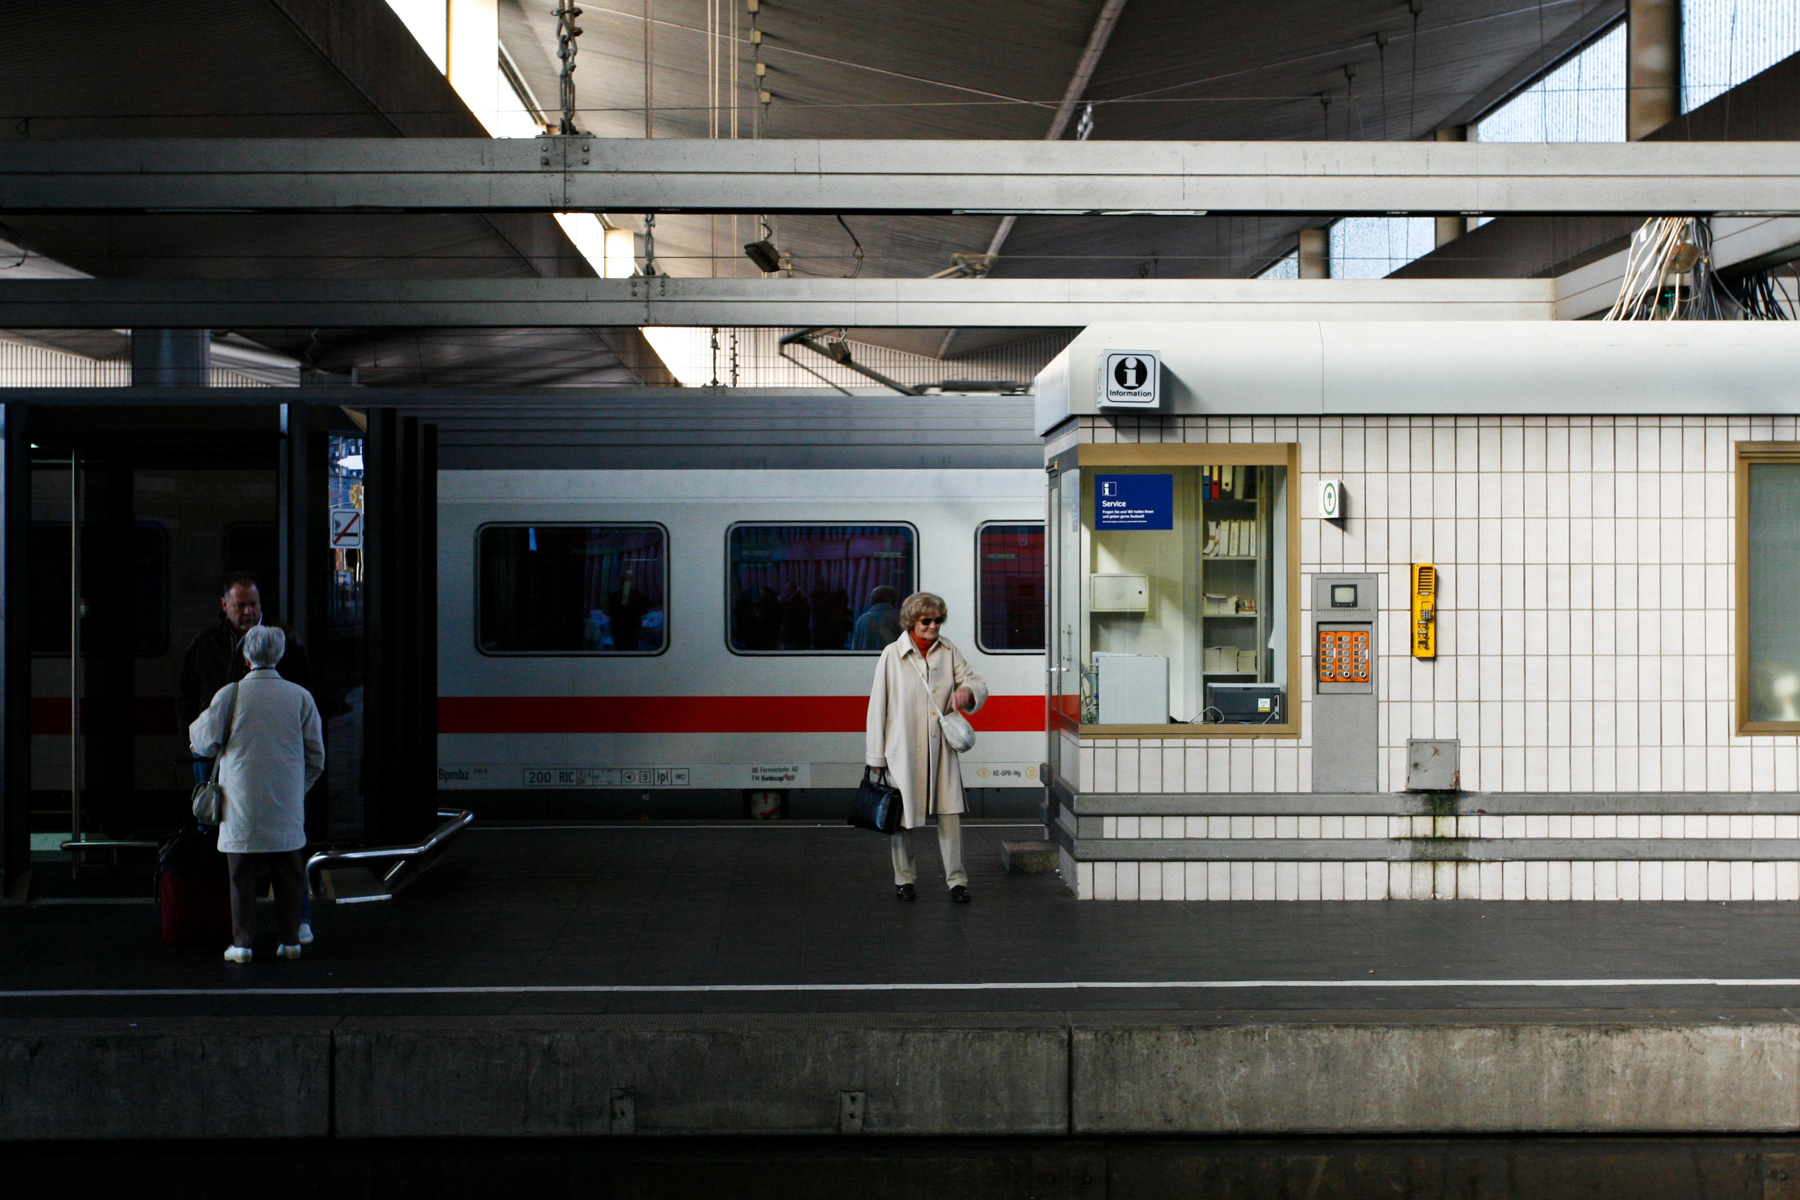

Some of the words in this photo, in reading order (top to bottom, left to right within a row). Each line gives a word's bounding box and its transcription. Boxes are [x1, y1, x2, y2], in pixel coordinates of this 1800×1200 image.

[1109, 389, 1152, 397] Information
[1102, 500, 1127, 508] Service
[438, 768, 470, 783] Bpmbz
[528, 771, 552, 783] 200
[558, 771, 575, 783] RIC
[642, 773, 648, 781] 9
[993, 769, 1022, 778] KE-GPR-Mg
